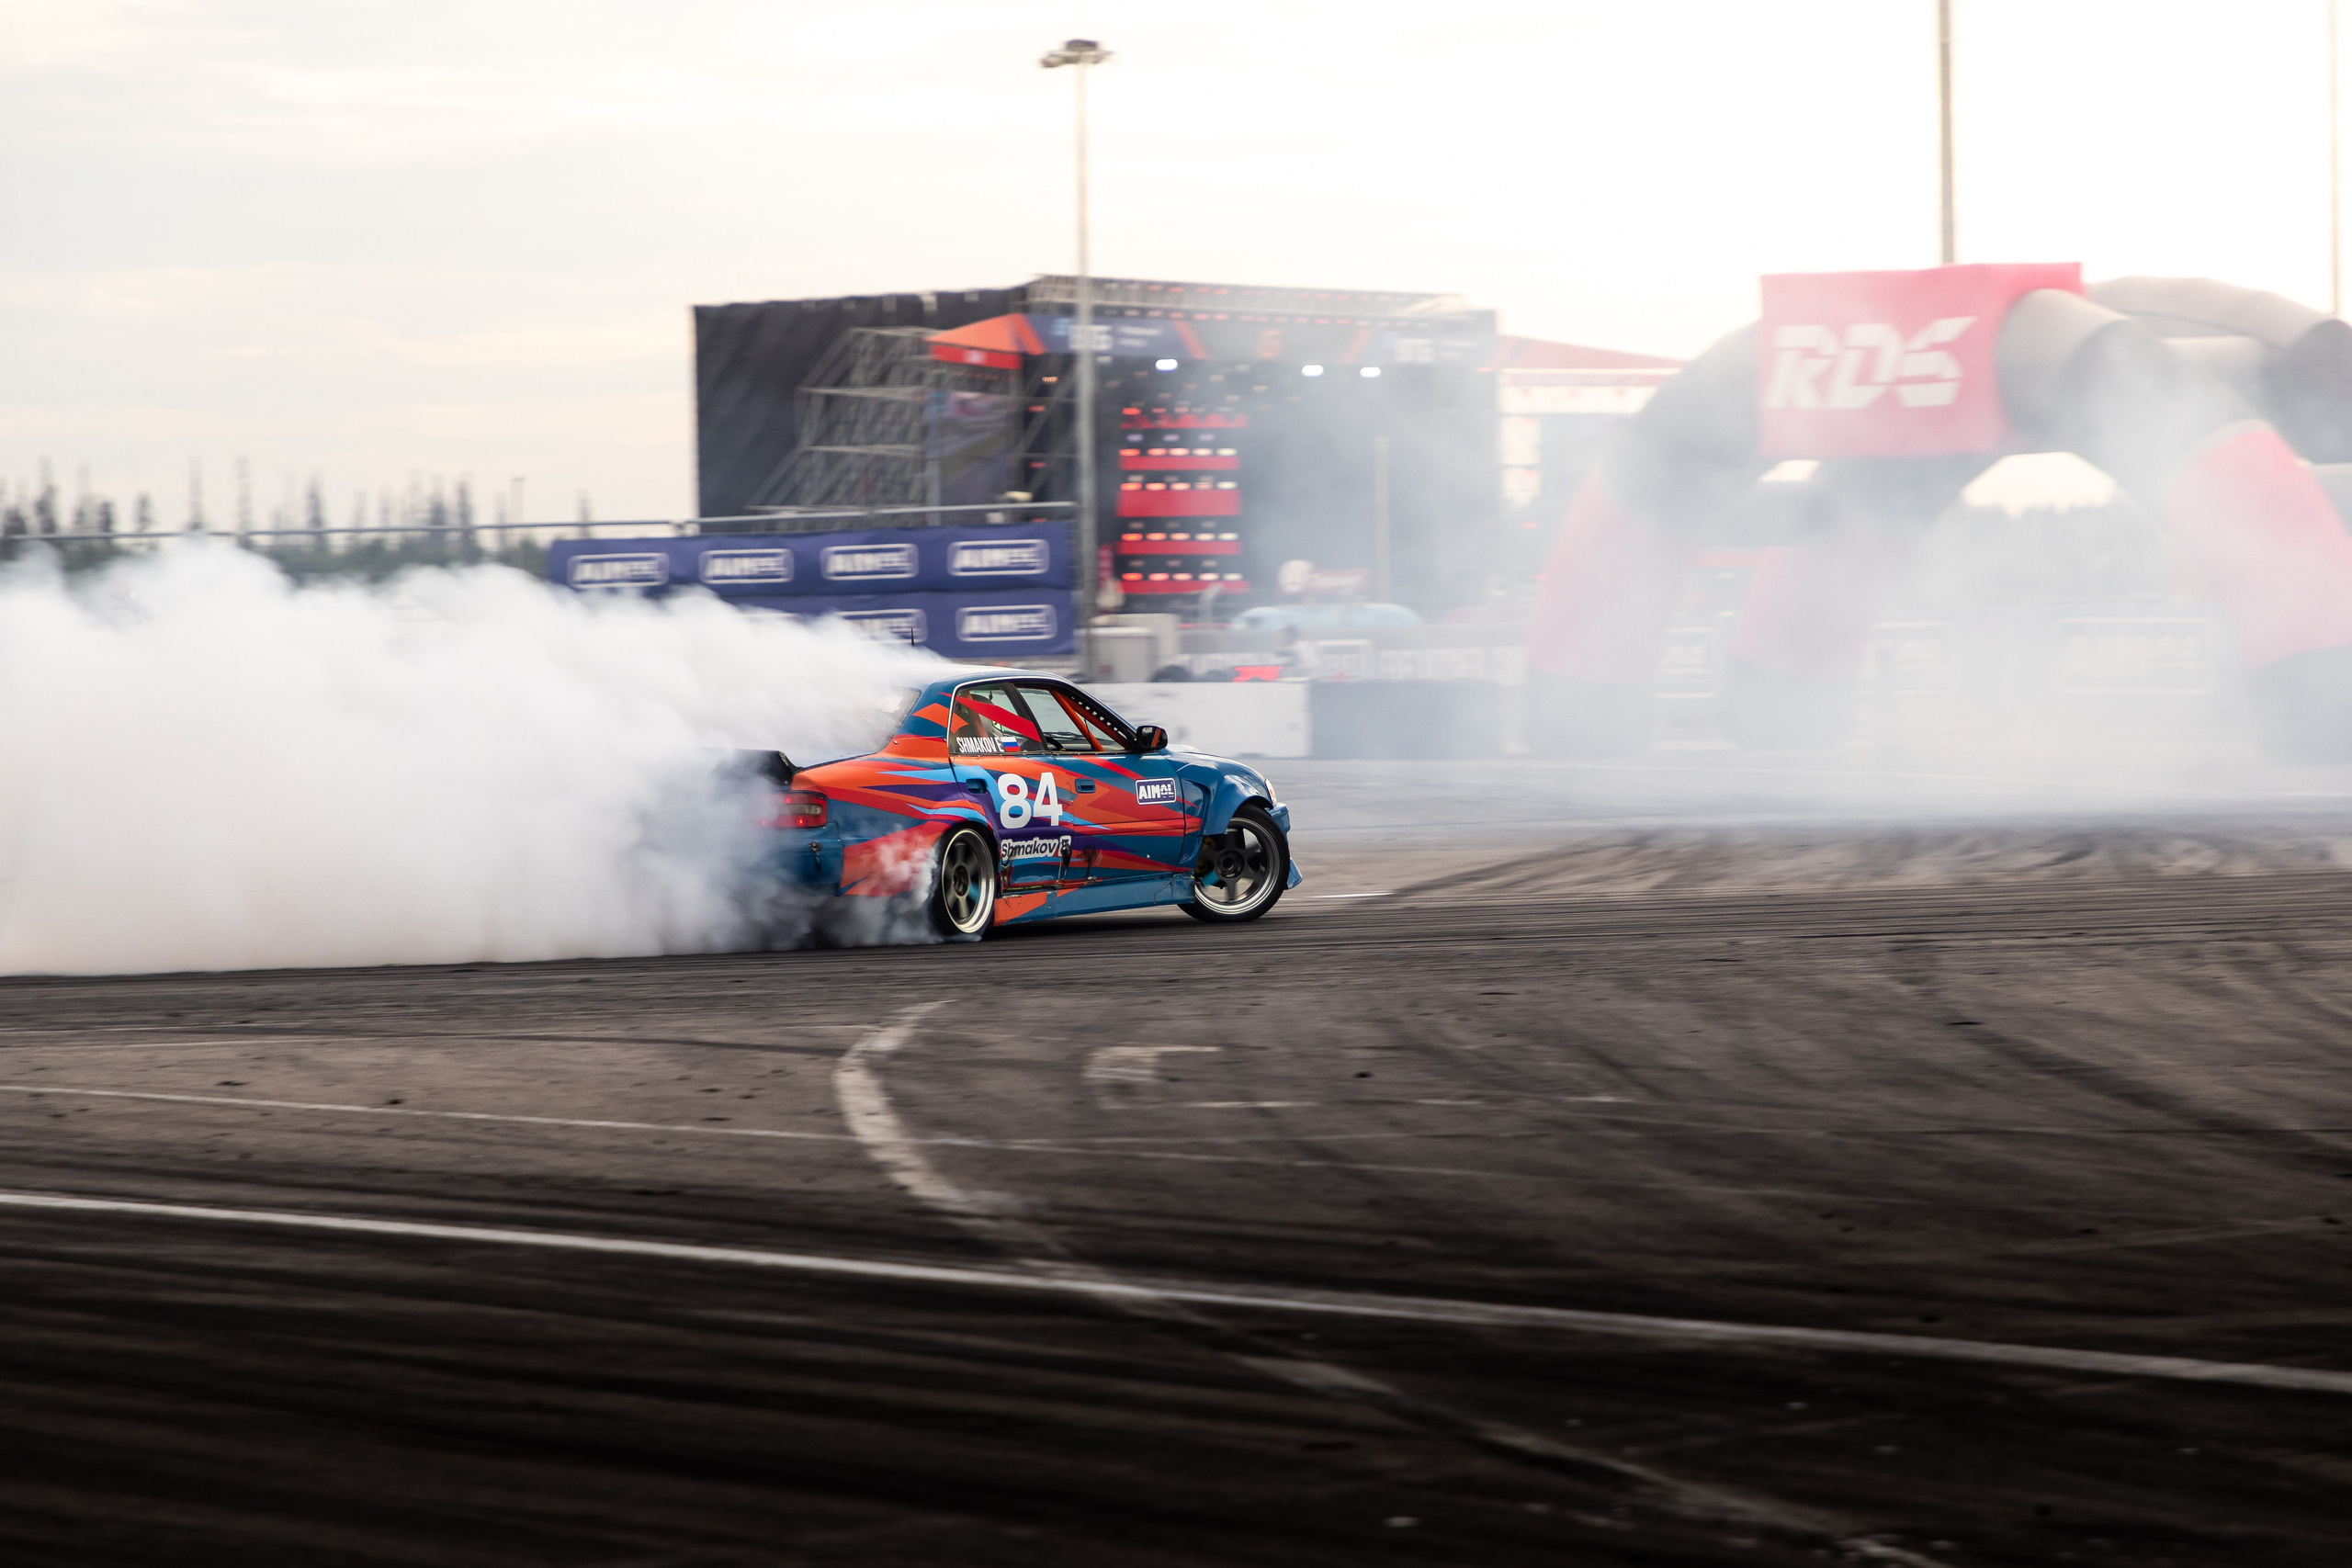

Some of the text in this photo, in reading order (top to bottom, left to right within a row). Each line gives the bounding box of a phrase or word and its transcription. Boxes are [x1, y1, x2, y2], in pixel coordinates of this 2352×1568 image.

[1764, 315, 1979, 410] RDS
[956, 736, 1004, 753] SHMAKOV E
[998, 772, 1063, 829] 84
[1138, 784, 1175, 800] AIMOL
[1001, 839, 1057, 859] Shmakov
